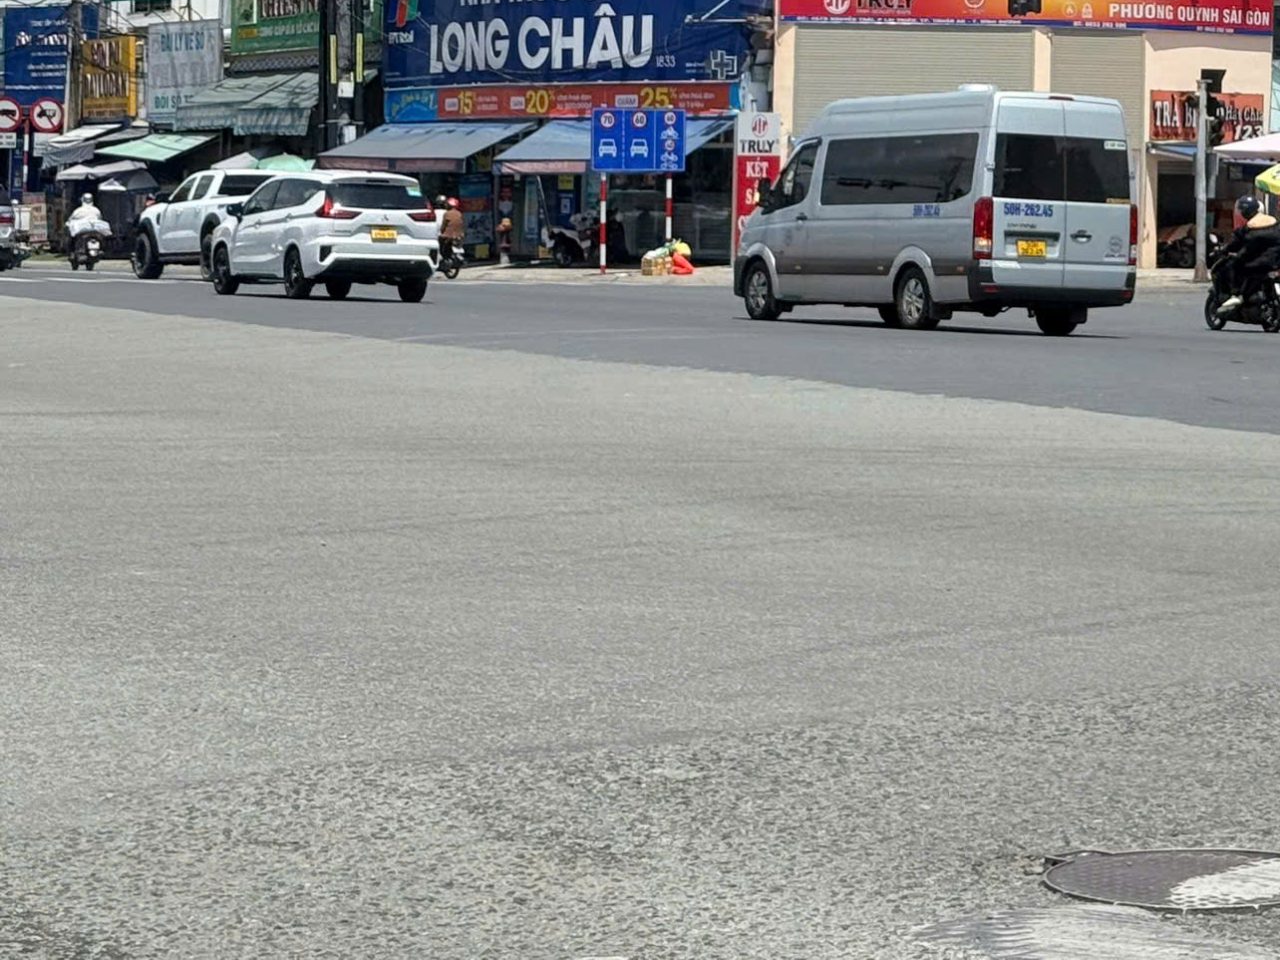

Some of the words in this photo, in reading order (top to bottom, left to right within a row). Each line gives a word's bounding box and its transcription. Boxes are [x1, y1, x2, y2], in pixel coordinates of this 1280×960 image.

[1109, 2, 1174, 20] PHƯƠNG
[1222, 5, 1242, 25] SÀI
[1246, 8, 1270, 26] GÒN
[429, 17, 510, 73] LONG
[518, 3, 653, 70] CHÂU
[1154, 93, 1180, 127] TRÀ
[603, 116, 612, 124] 70
[636, 116, 644, 124] 60
[1234, 124, 1263, 141] 123
[740, 140, 775, 153] TRULY
[746, 156, 769, 178] KÉT
[1004, 202, 1054, 217] 50H-262.45
